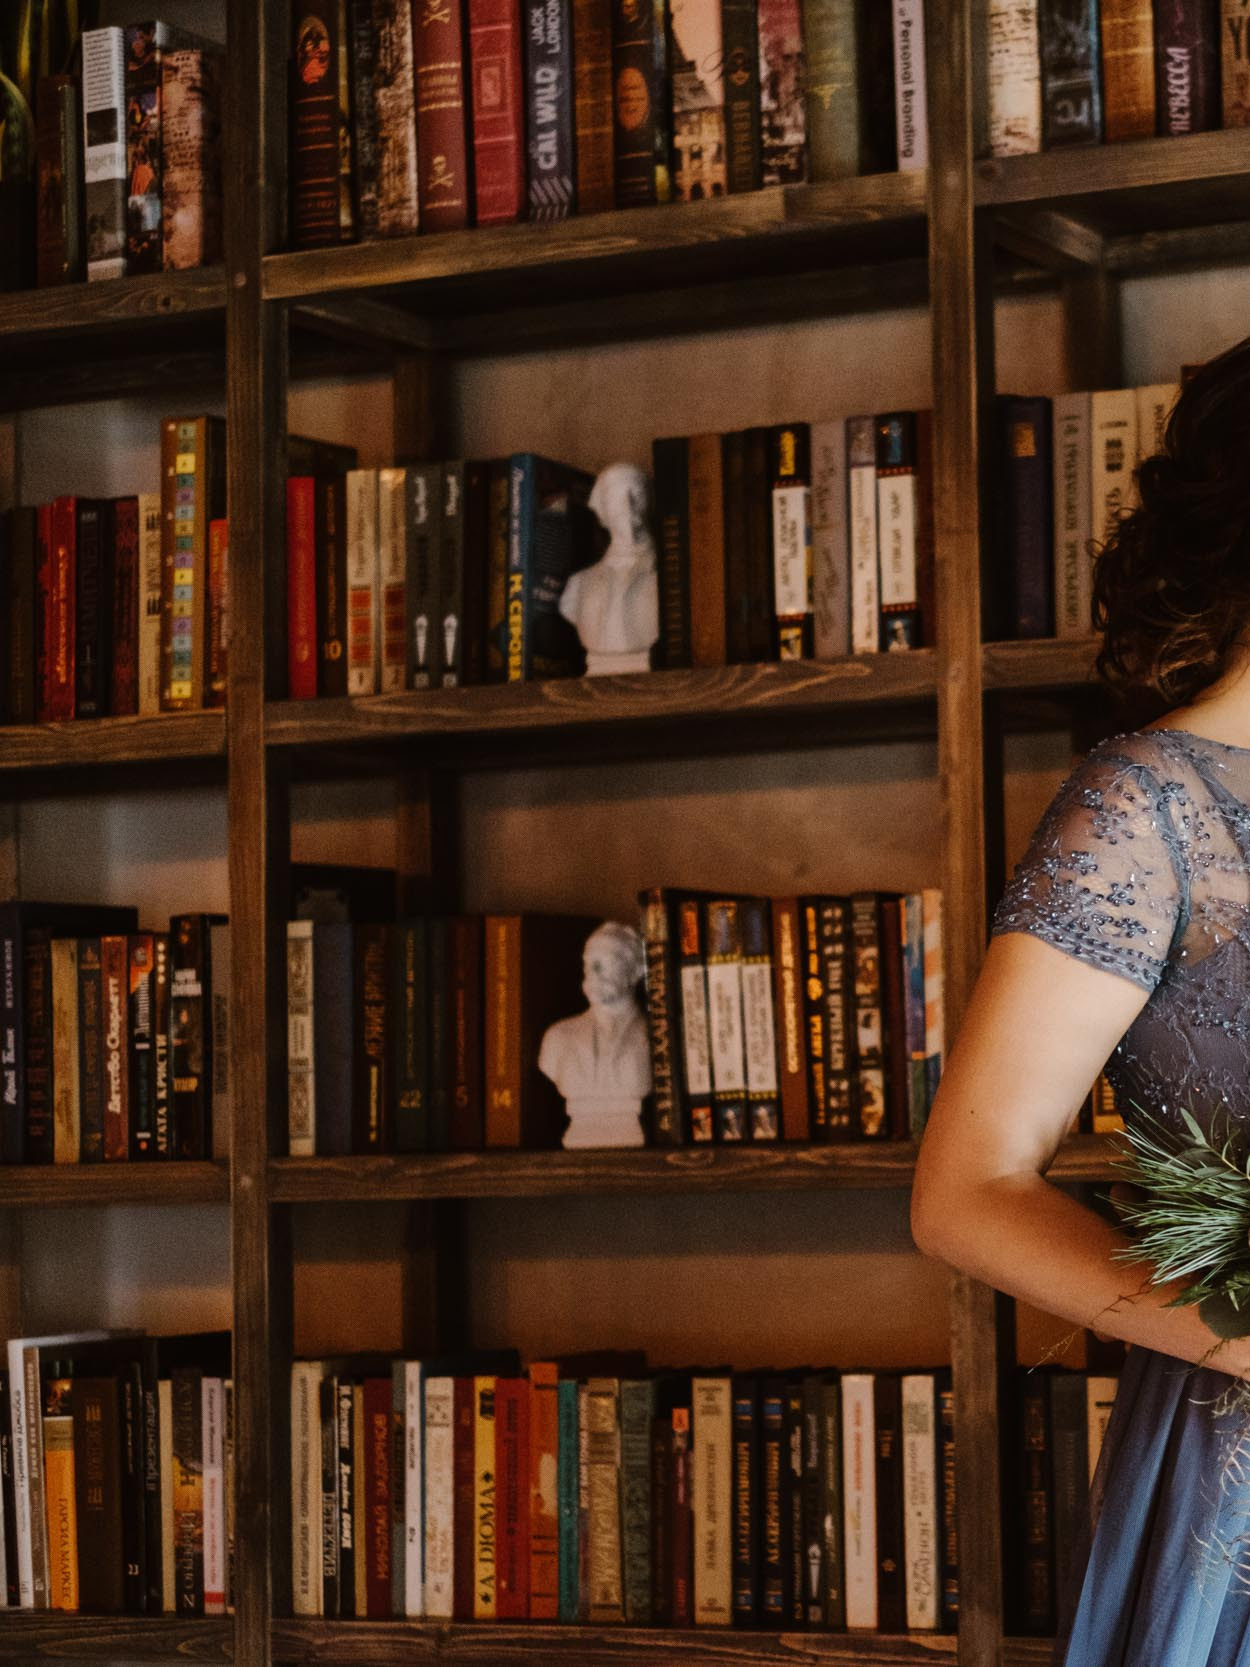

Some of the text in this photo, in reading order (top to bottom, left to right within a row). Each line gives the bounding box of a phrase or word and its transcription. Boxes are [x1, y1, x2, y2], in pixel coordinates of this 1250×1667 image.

[531, 6, 545, 46] JACK
[901, 20, 917, 159] Personal Branding
